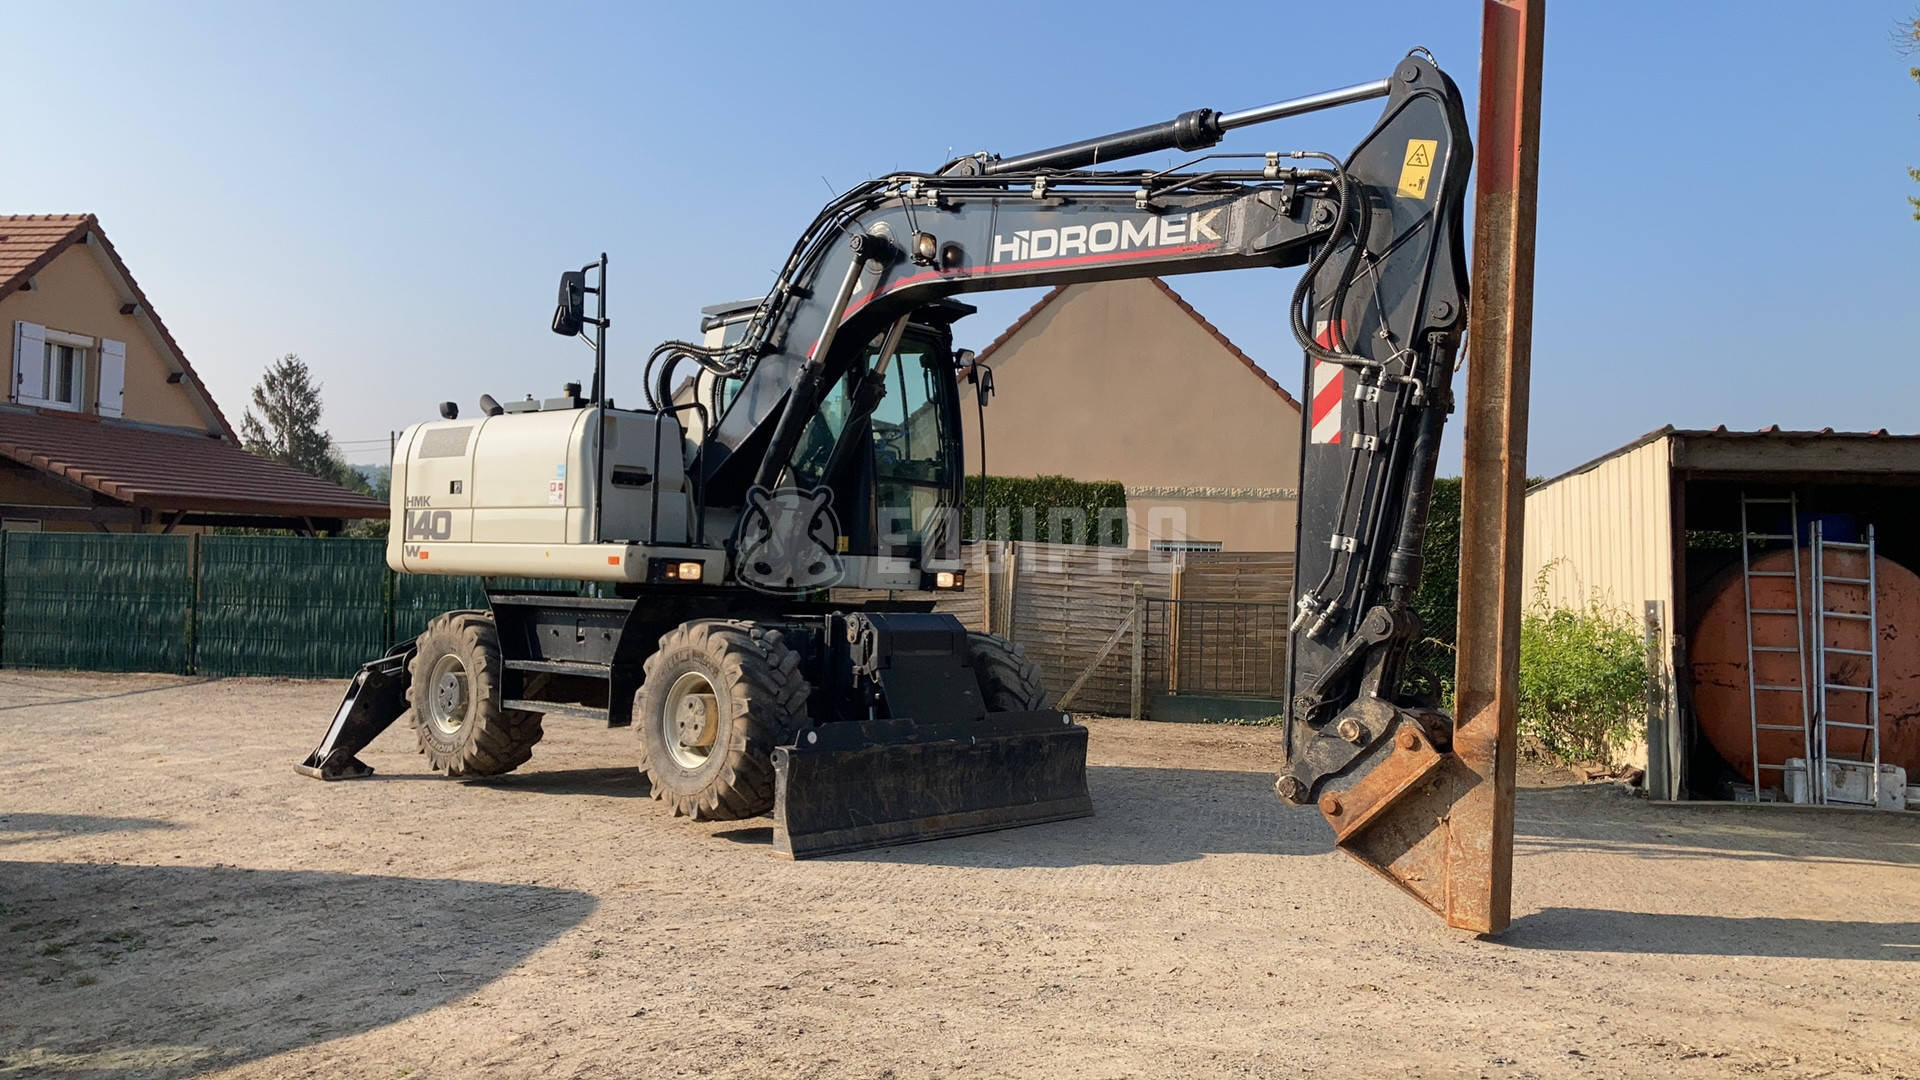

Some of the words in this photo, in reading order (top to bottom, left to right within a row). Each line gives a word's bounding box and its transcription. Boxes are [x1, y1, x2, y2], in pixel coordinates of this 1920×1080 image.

[406, 495, 431, 507] HMK
[407, 511, 452, 540] 140
[405, 545, 420, 557] W
